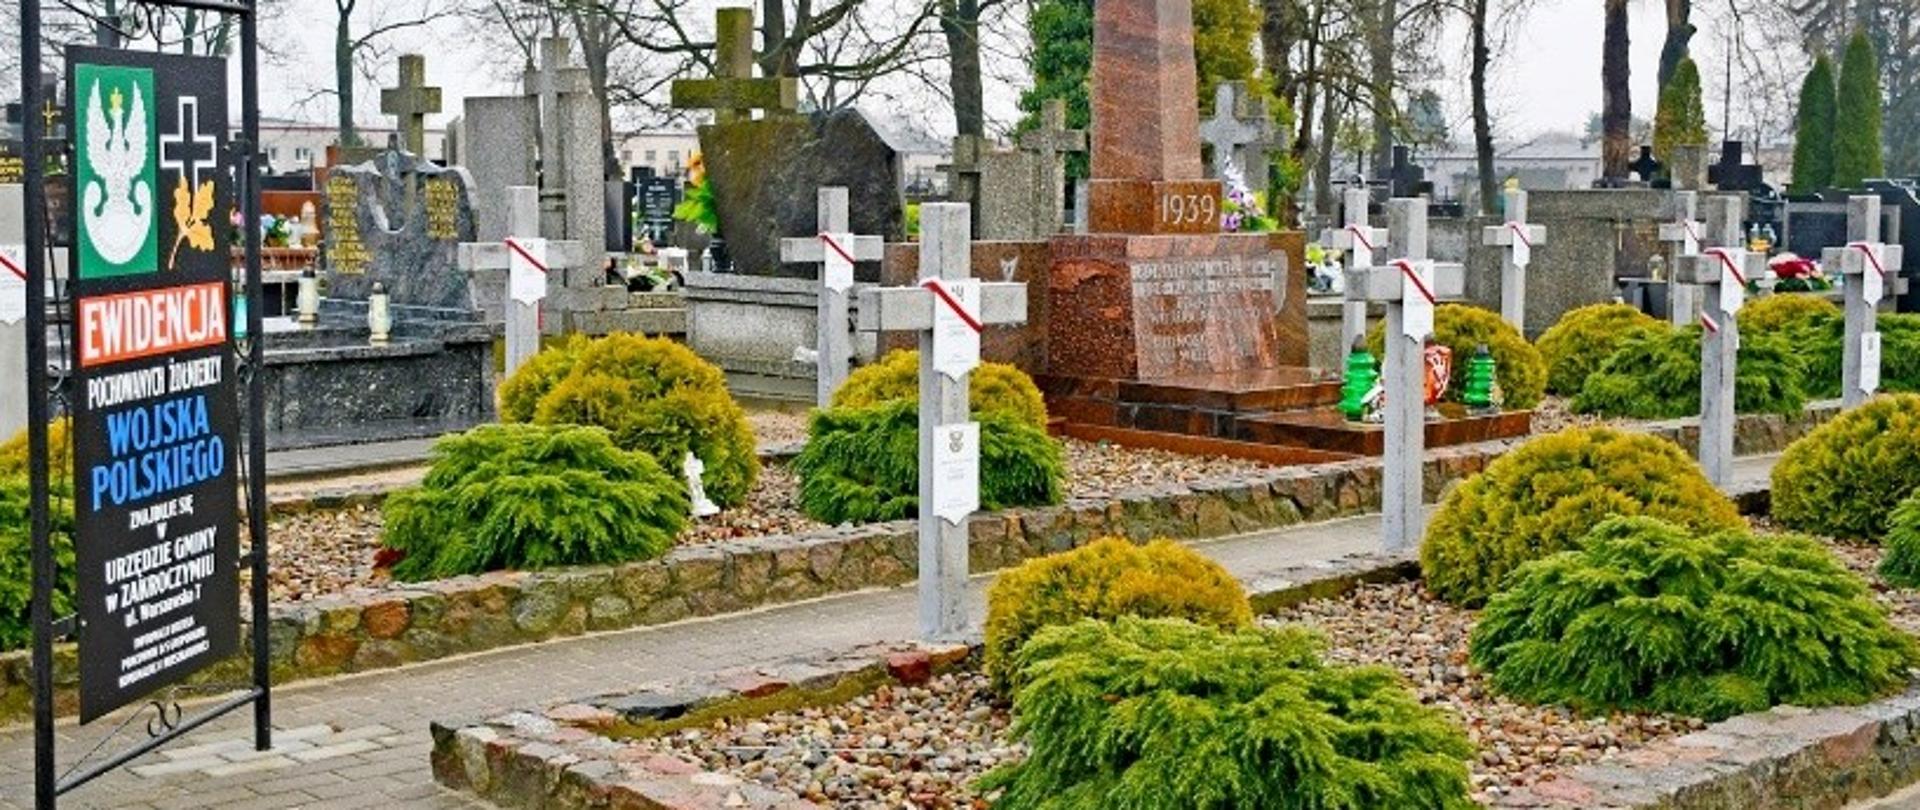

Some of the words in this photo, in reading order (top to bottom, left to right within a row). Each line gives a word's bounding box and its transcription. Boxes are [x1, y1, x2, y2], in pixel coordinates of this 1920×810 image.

[1162, 193, 1214, 224] 1939
[83, 286, 226, 361] EWIDENCJA
[87, 365, 165, 411] POCHOWANYCH
[107, 395, 210, 457] WOJSKA
[92, 434, 224, 512] POLSKIEGO
[105, 540, 172, 585] URZĘDZIE
[174, 525, 217, 560] GMINY
[120, 553, 215, 609] ZAKROCZYMIU
